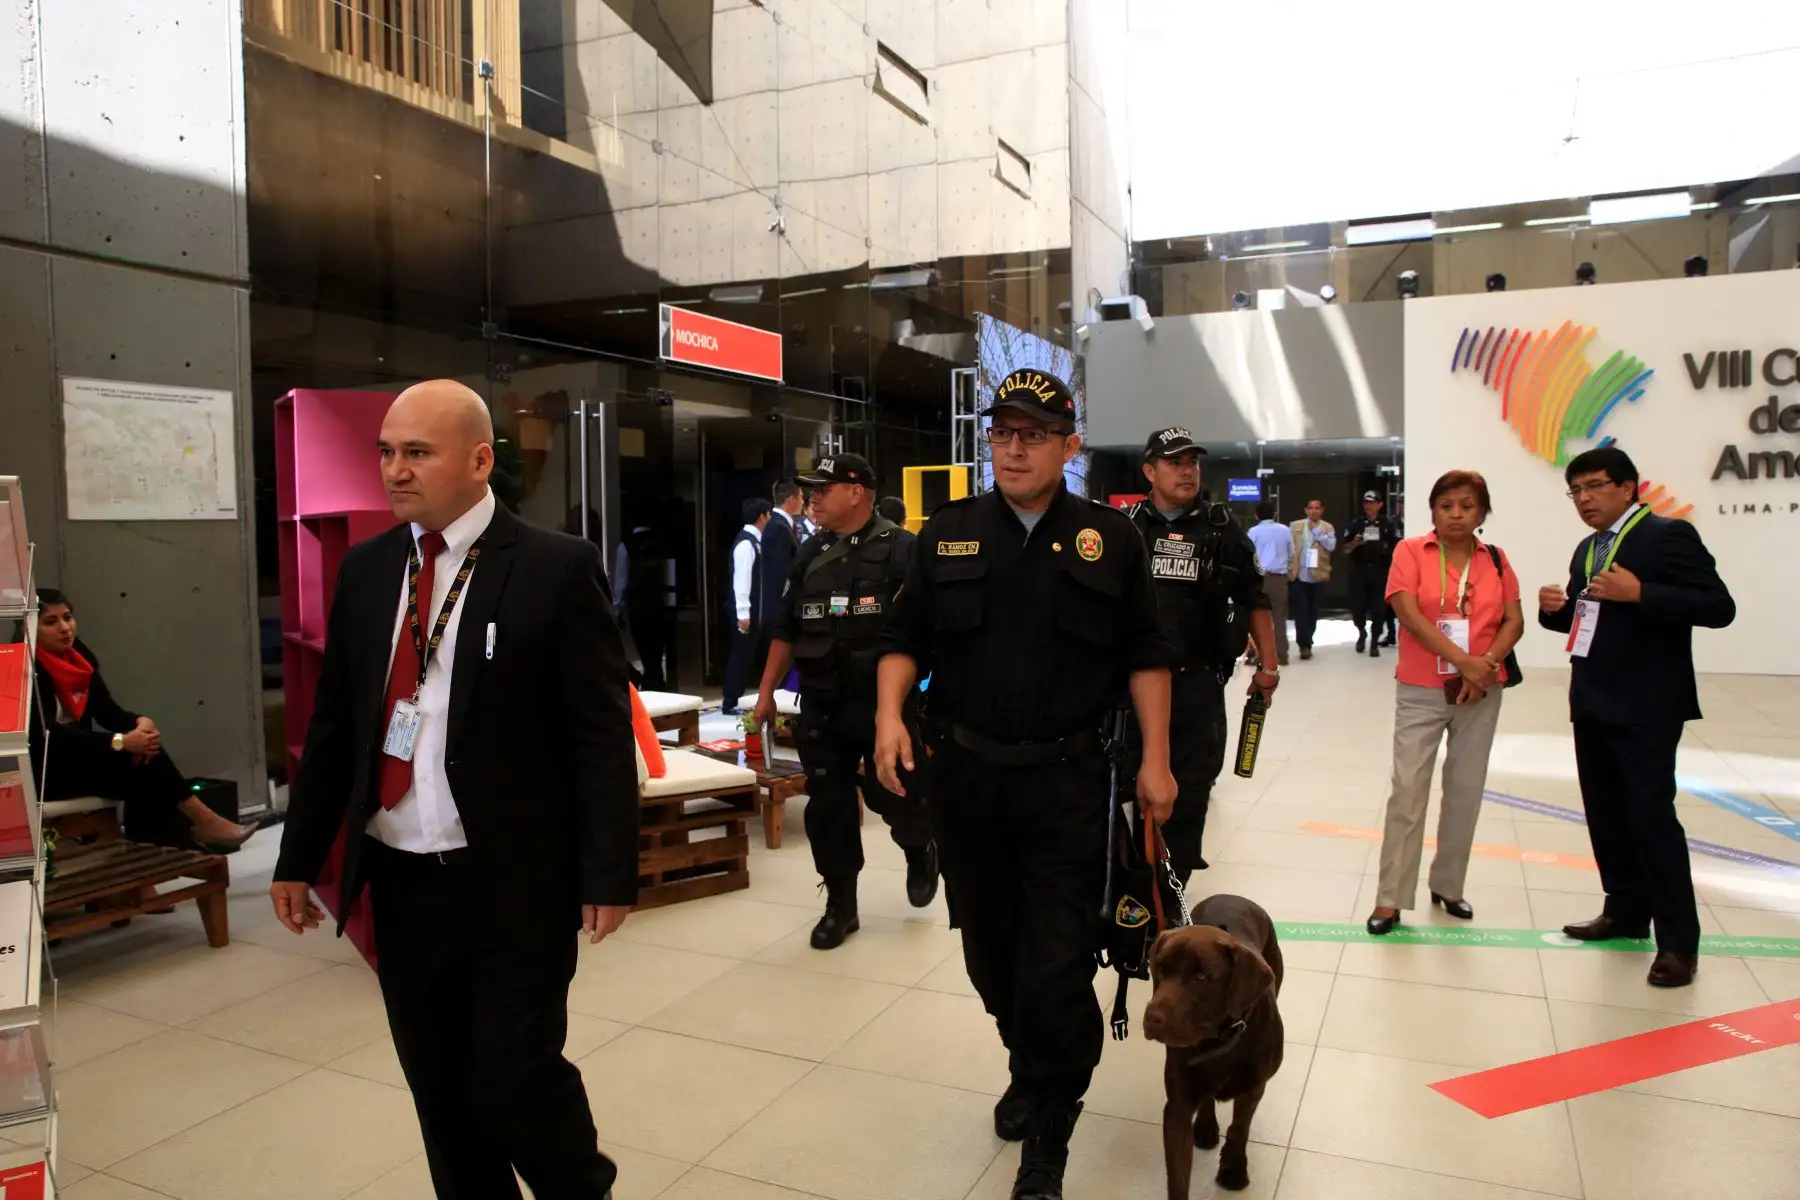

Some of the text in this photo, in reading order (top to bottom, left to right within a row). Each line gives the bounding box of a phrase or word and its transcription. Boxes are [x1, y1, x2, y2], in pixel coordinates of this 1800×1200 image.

[675, 327, 719, 351] MOCHICA
[1683, 347, 1800, 390] VIII C
[999, 372, 1056, 403] POLICIA
[1710, 443, 1800, 481] Am
[1718, 503, 1773, 515] LIMA
[1153, 558, 1195, 577] POLICIA
[1708, 1022, 1768, 1044] flickr
